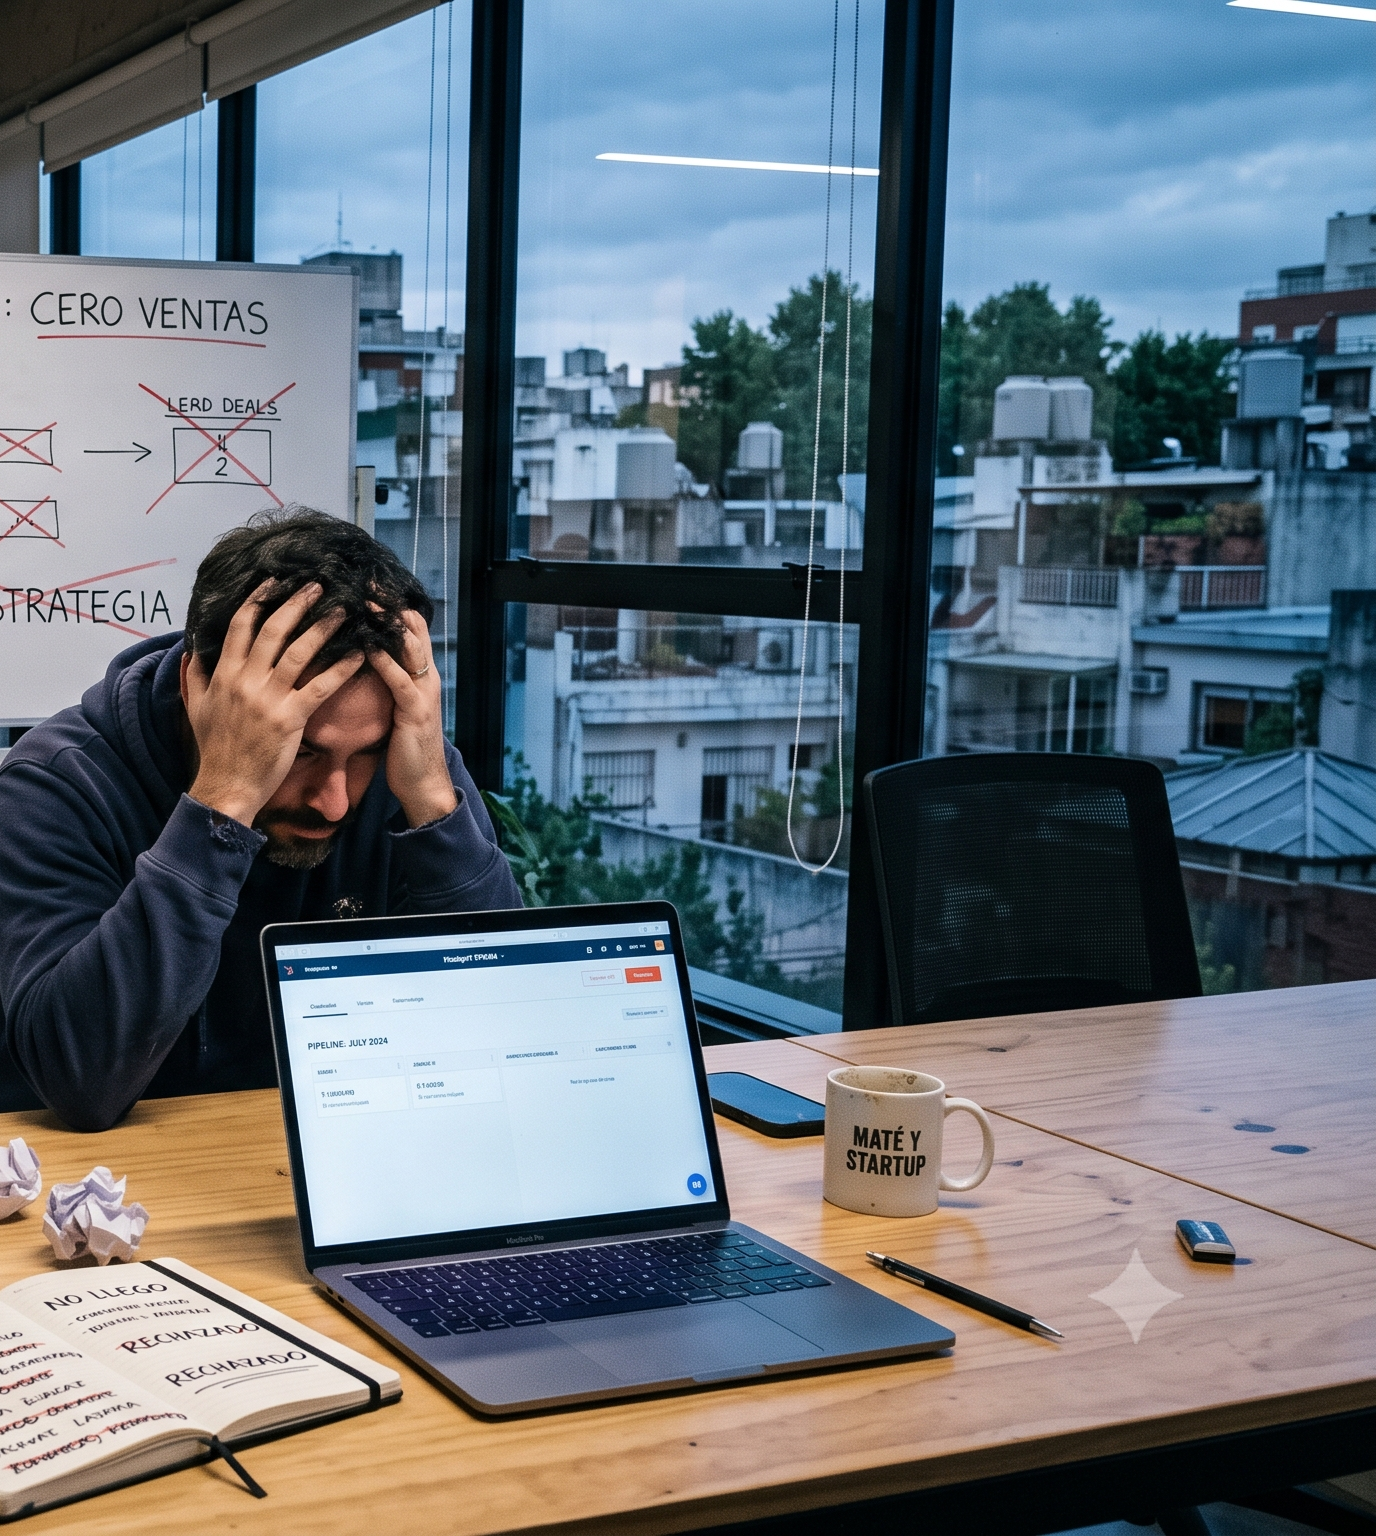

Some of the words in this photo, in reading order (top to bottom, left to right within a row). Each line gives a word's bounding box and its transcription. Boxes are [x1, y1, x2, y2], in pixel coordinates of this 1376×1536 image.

[30, 291, 123, 327] CERO
[138, 297, 269, 335] VENTAS
[223, 397, 278, 415] DEALS
[214, 456, 228, 477] 2
[307, 1040, 346, 1050] PIPELINE:
[348, 1038, 367, 1048] JULY
[368, 1036, 388, 1047] 2024
[853, 1125, 904, 1151] MATÉ
[910, 1130, 922, 1152] Y
[846, 1149, 926, 1177] STARTUP
[43, 1294, 83, 1312] NO
[87, 1283, 168, 1300] LLEGO
[120, 1322, 260, 1354] RECHAZADO
[165, 1350, 308, 1388] RECHAZADO
